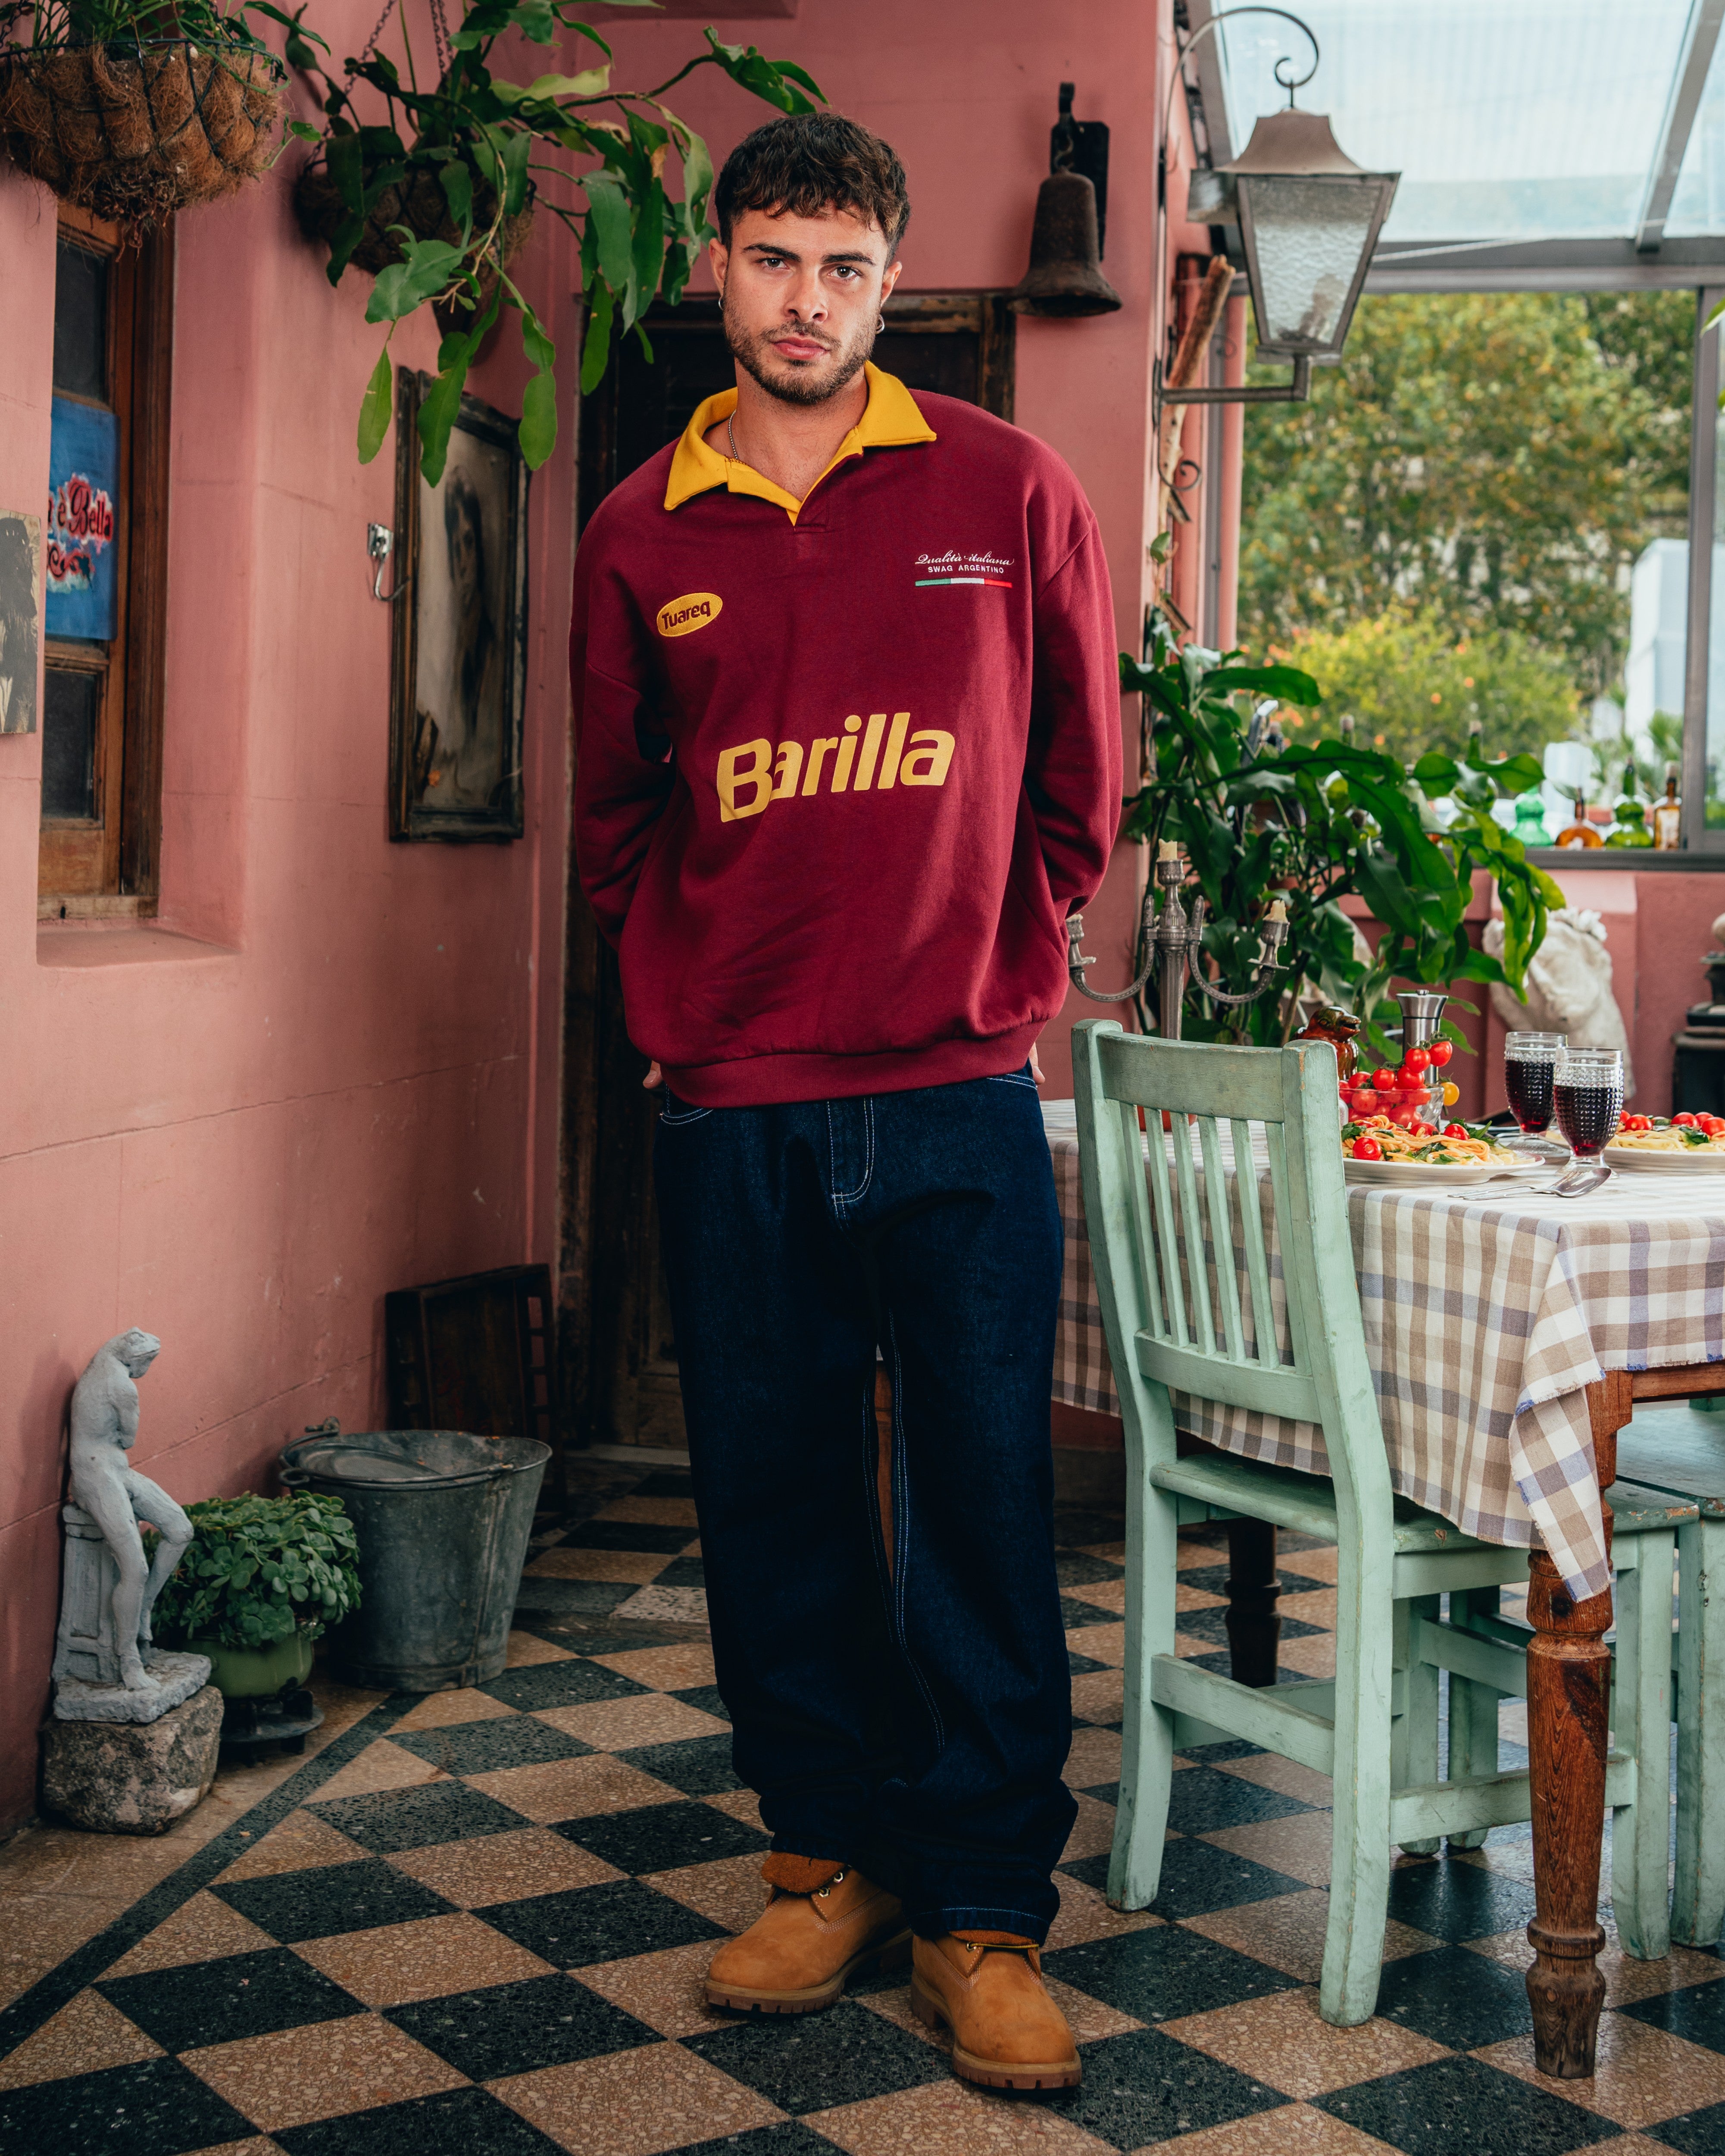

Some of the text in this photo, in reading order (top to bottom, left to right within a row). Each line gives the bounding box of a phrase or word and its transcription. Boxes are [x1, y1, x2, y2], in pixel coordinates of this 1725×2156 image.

[69, 482, 111, 537] Bella
[915, 550, 1015, 566] Qualità italiana
[958, 564, 1004, 574] ARGENTINO
[716, 712, 956, 823] Barilla
